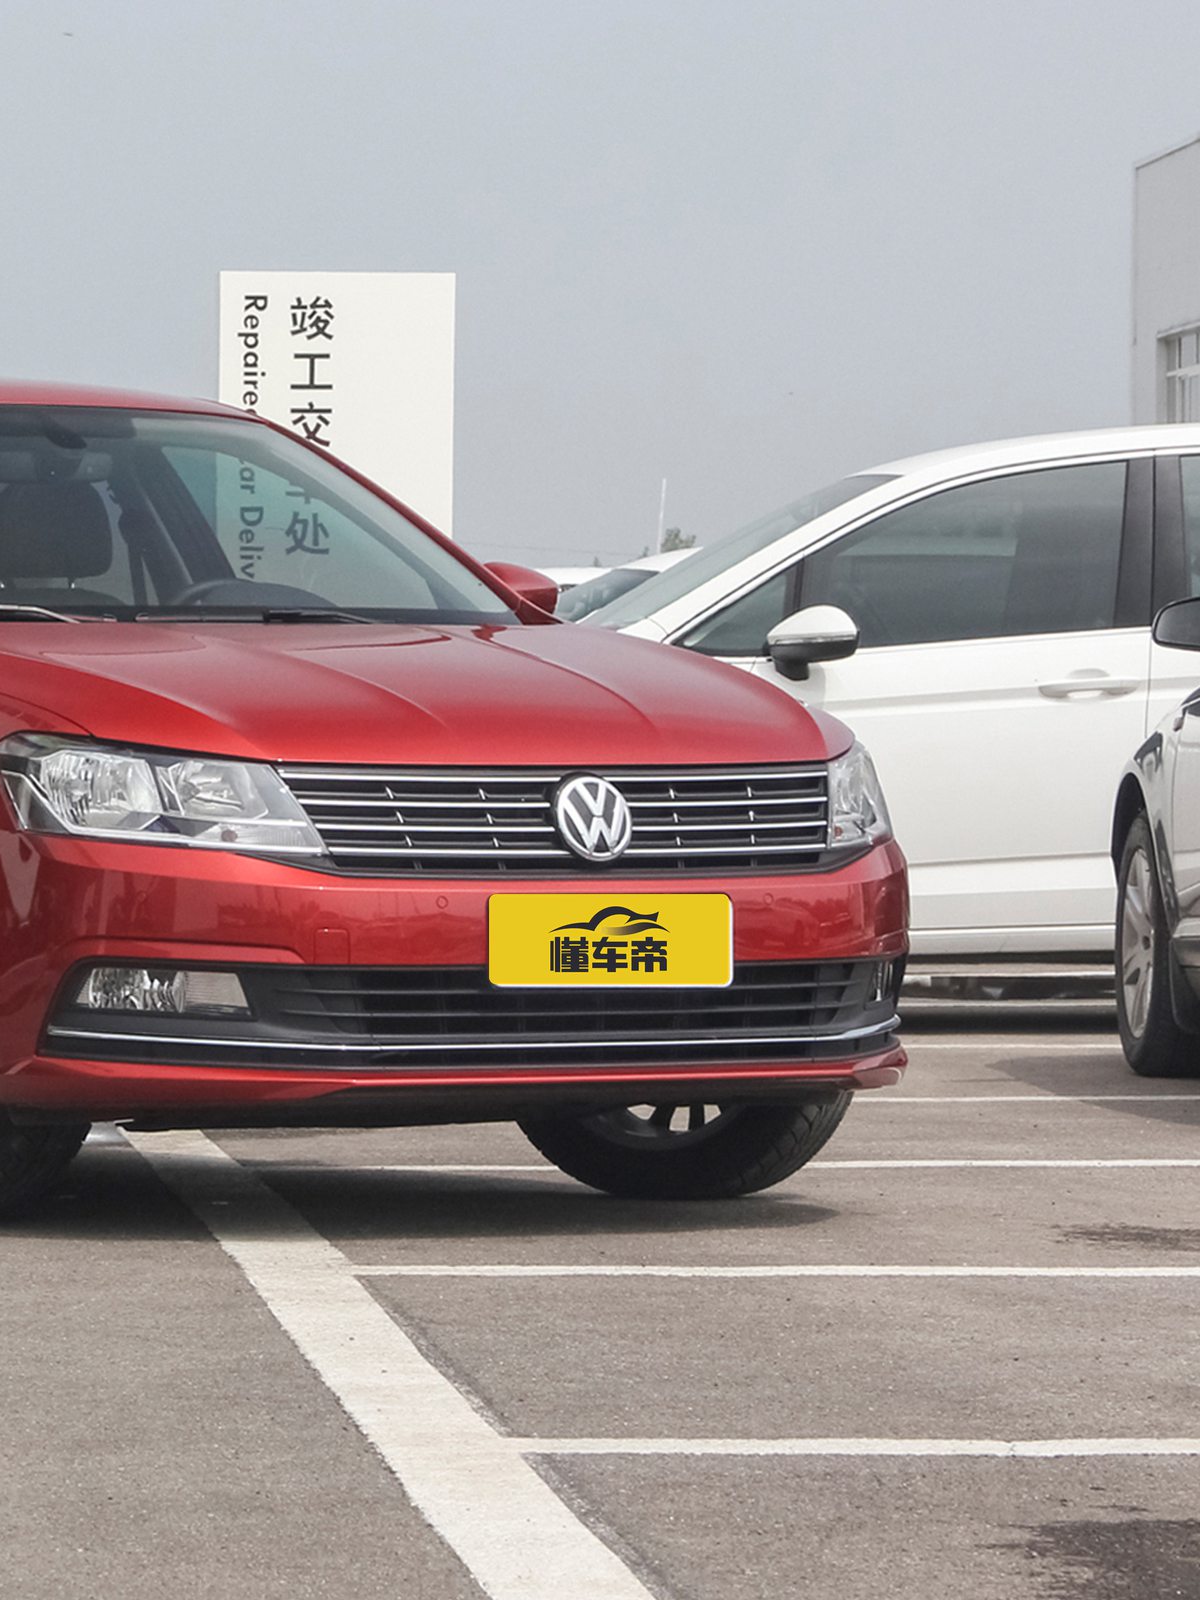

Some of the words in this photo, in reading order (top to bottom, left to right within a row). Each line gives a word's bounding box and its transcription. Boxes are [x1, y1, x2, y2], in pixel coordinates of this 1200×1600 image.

[238, 459, 256, 495] ar
[285, 296, 335, 556] 竣工交处
